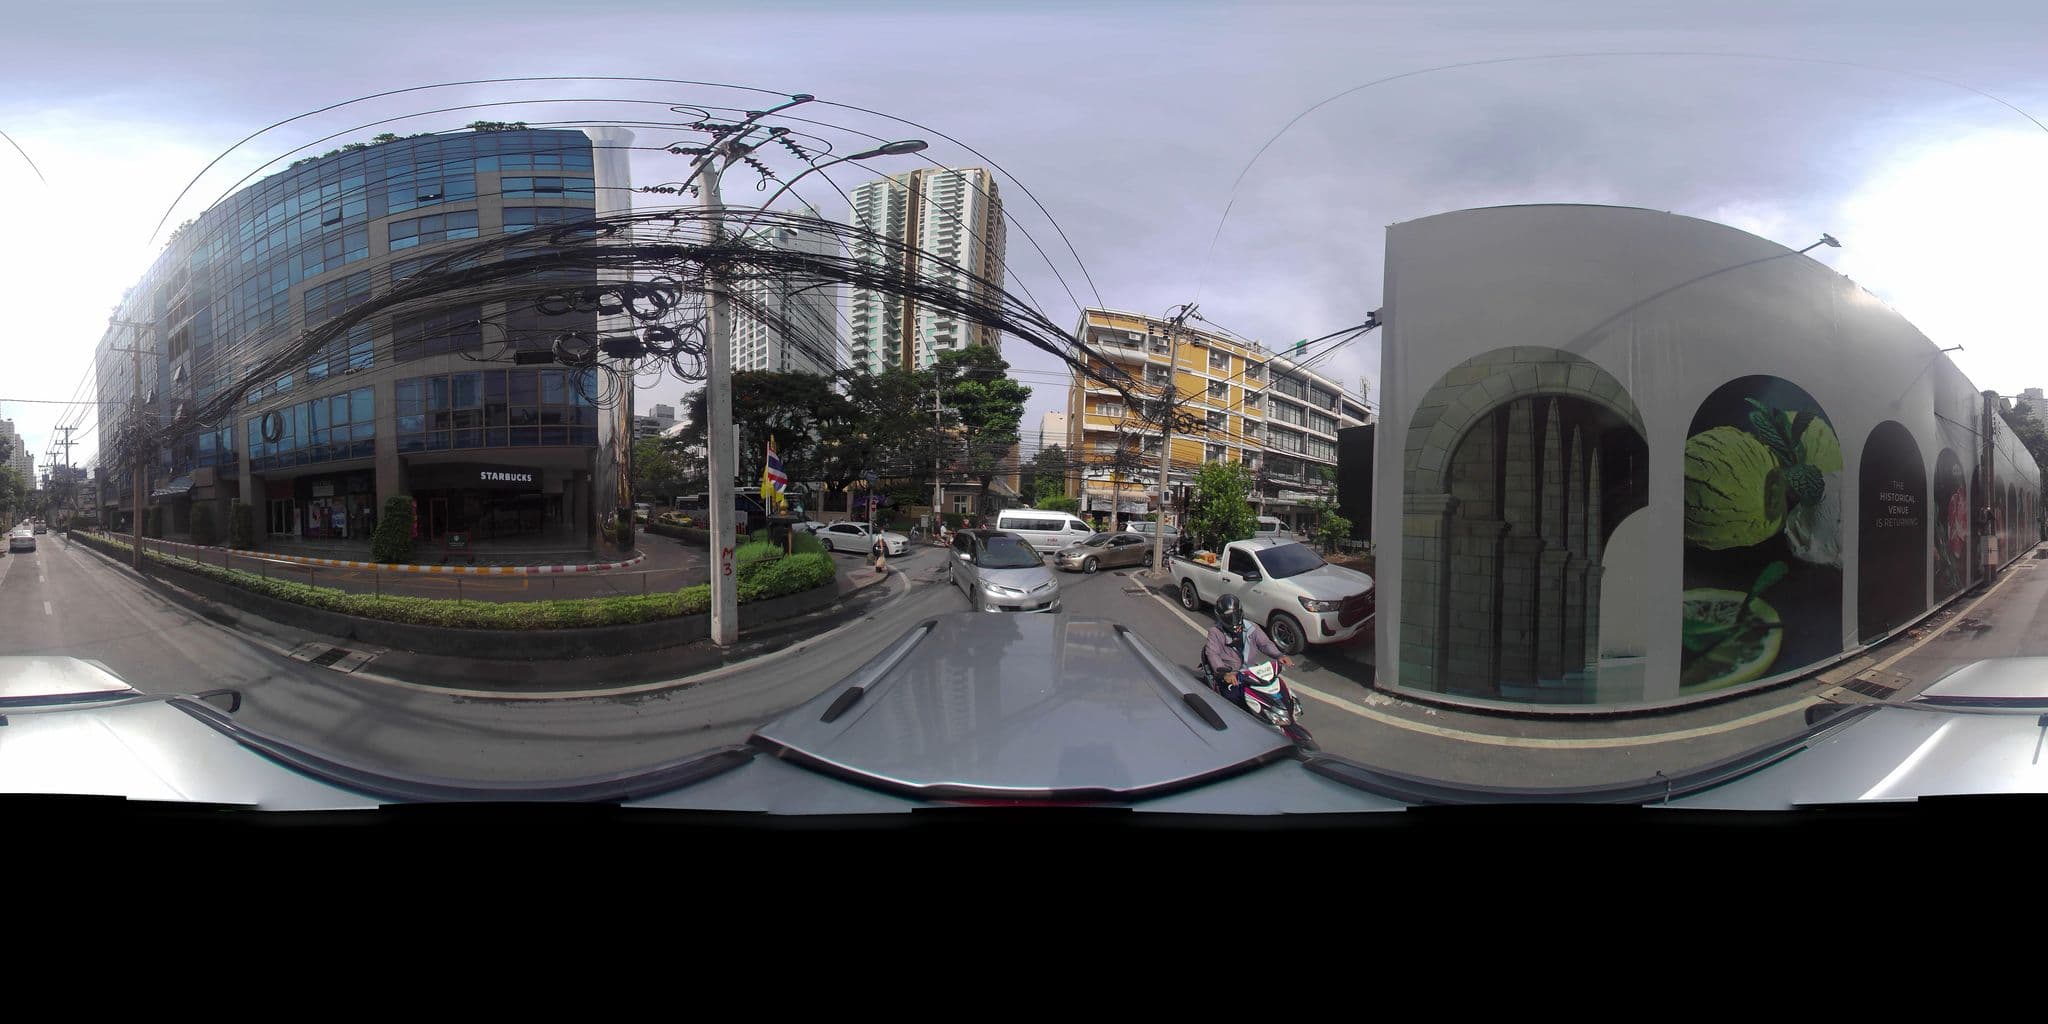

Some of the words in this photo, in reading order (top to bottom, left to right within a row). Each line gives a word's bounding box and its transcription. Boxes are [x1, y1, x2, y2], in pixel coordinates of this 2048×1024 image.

[480, 471, 532, 482] STARBUCKS
[1892, 480, 1905, 490] THE
[1879, 491, 1917, 504] HISTORICAL
[1887, 505, 1910, 514] VENUE
[722, 547, 733, 559] M
[723, 563, 733, 576] 3
